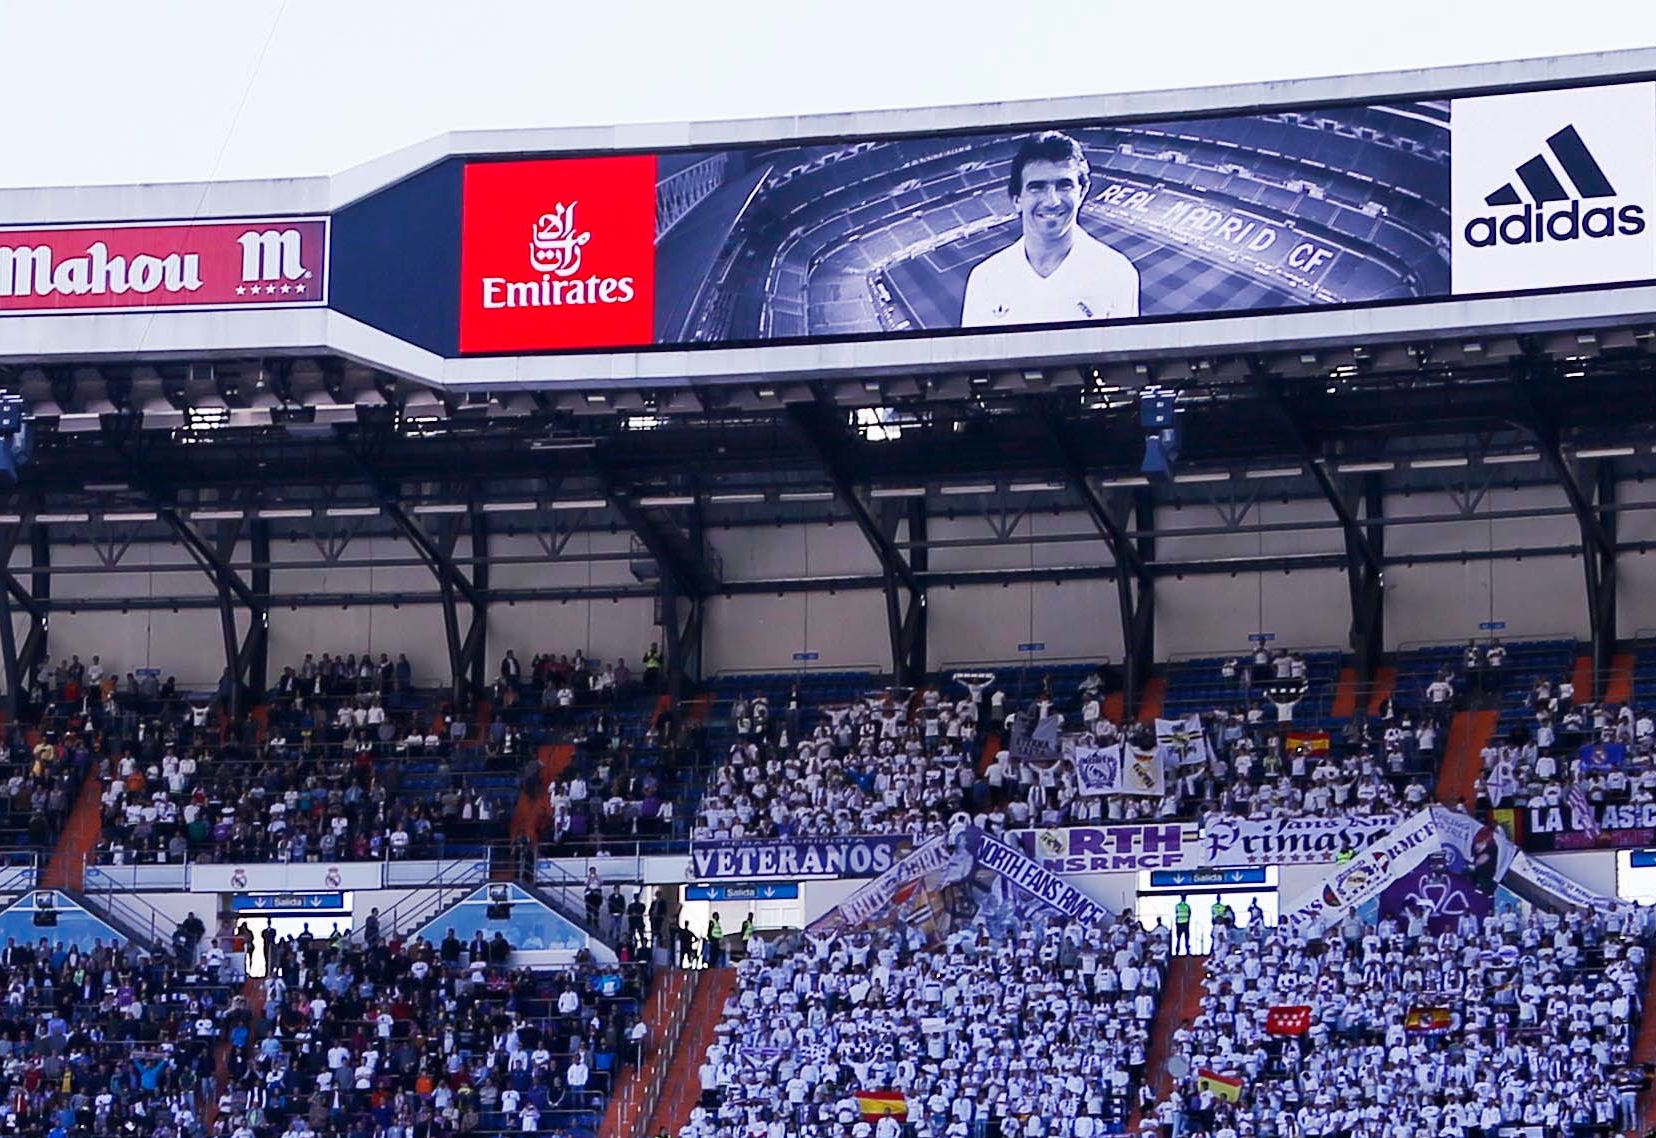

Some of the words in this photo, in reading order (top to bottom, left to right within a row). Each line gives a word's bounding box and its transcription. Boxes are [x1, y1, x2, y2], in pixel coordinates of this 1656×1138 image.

[1097, 184, 1156, 212] REAL
[1161, 199, 1277, 252] MADRID
[1464, 199, 1646, 248] adidas
[482, 274, 634, 308] Emirates
[1531, 807, 1563, 833] LA
[1390, 822, 1437, 861] RMCF
[694, 843, 892, 877] VETERANOS
[1193, 872, 1223, 882] Salida
[727, 887, 755, 898] Salida
[978, 837, 1026, 881] NORTH
[1021, 864, 1064, 899] FANS
[1059, 886, 1106, 925] RMCF
[273, 898, 303, 908] Salida
